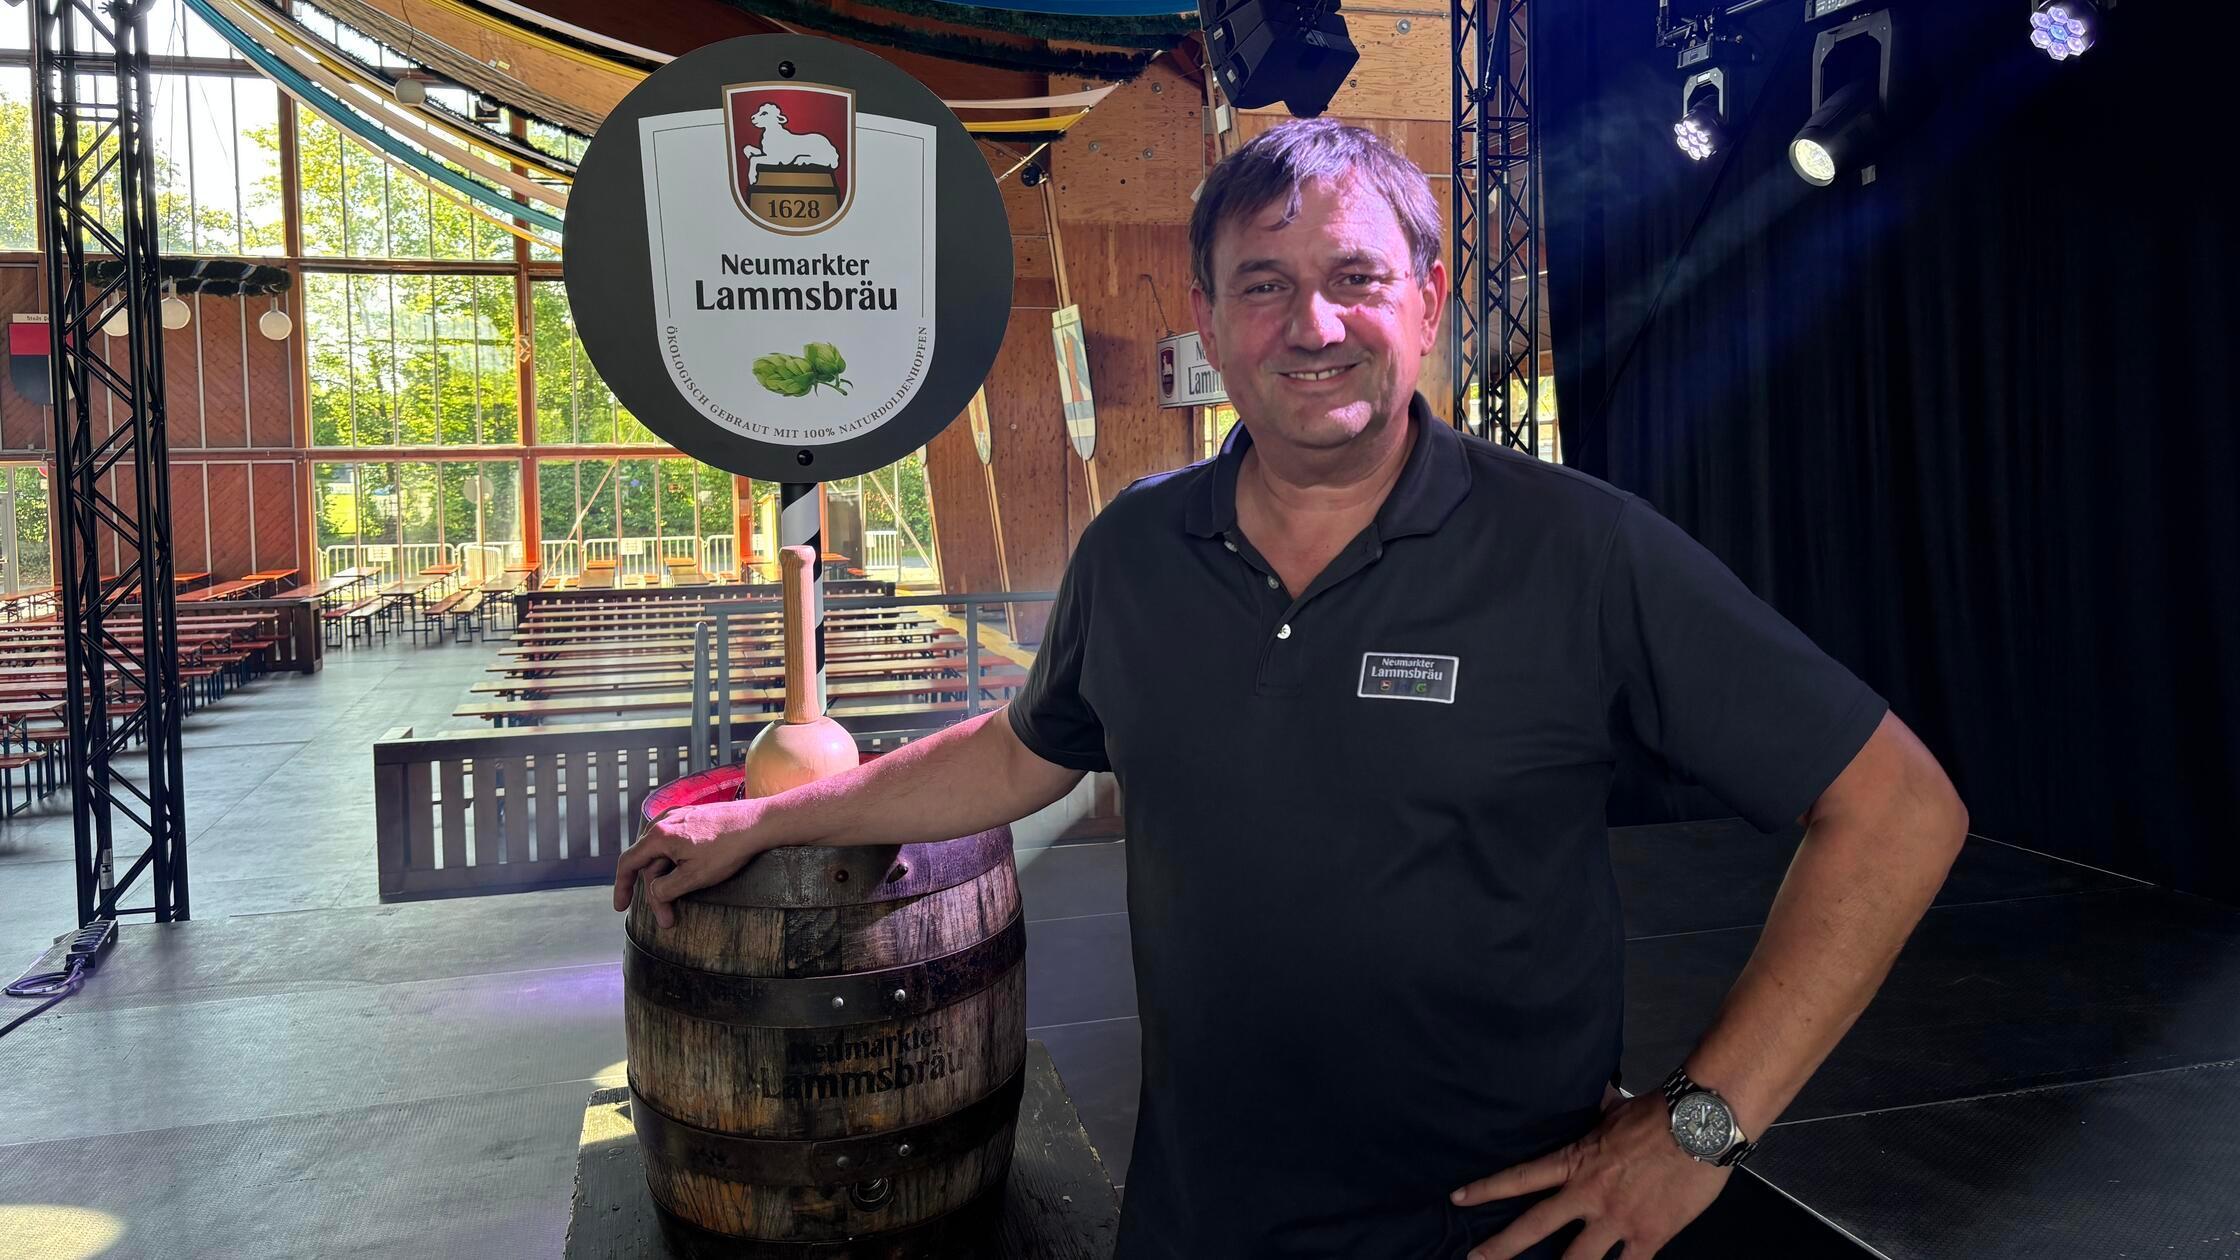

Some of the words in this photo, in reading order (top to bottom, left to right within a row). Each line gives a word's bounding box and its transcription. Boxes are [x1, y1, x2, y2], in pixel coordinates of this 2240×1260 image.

[768, 199, 820, 219] 1628
[721, 253, 870, 276] Neumarkter
[695, 280, 898, 311] Lammsbräu
[666, 325, 709, 405] ÖKOLOGISCH
[710, 404, 770, 435] GEBRAUT
[773, 428, 799, 438] MIT
[804, 427, 836, 439] 100%
[838, 326, 928, 434] NATURDOLDENHOPFEN
[1188, 367, 1224, 395] Lamm
[1371, 666, 1443, 680] Lammsbräu
[1382, 658, 1435, 668] Neumarkter
